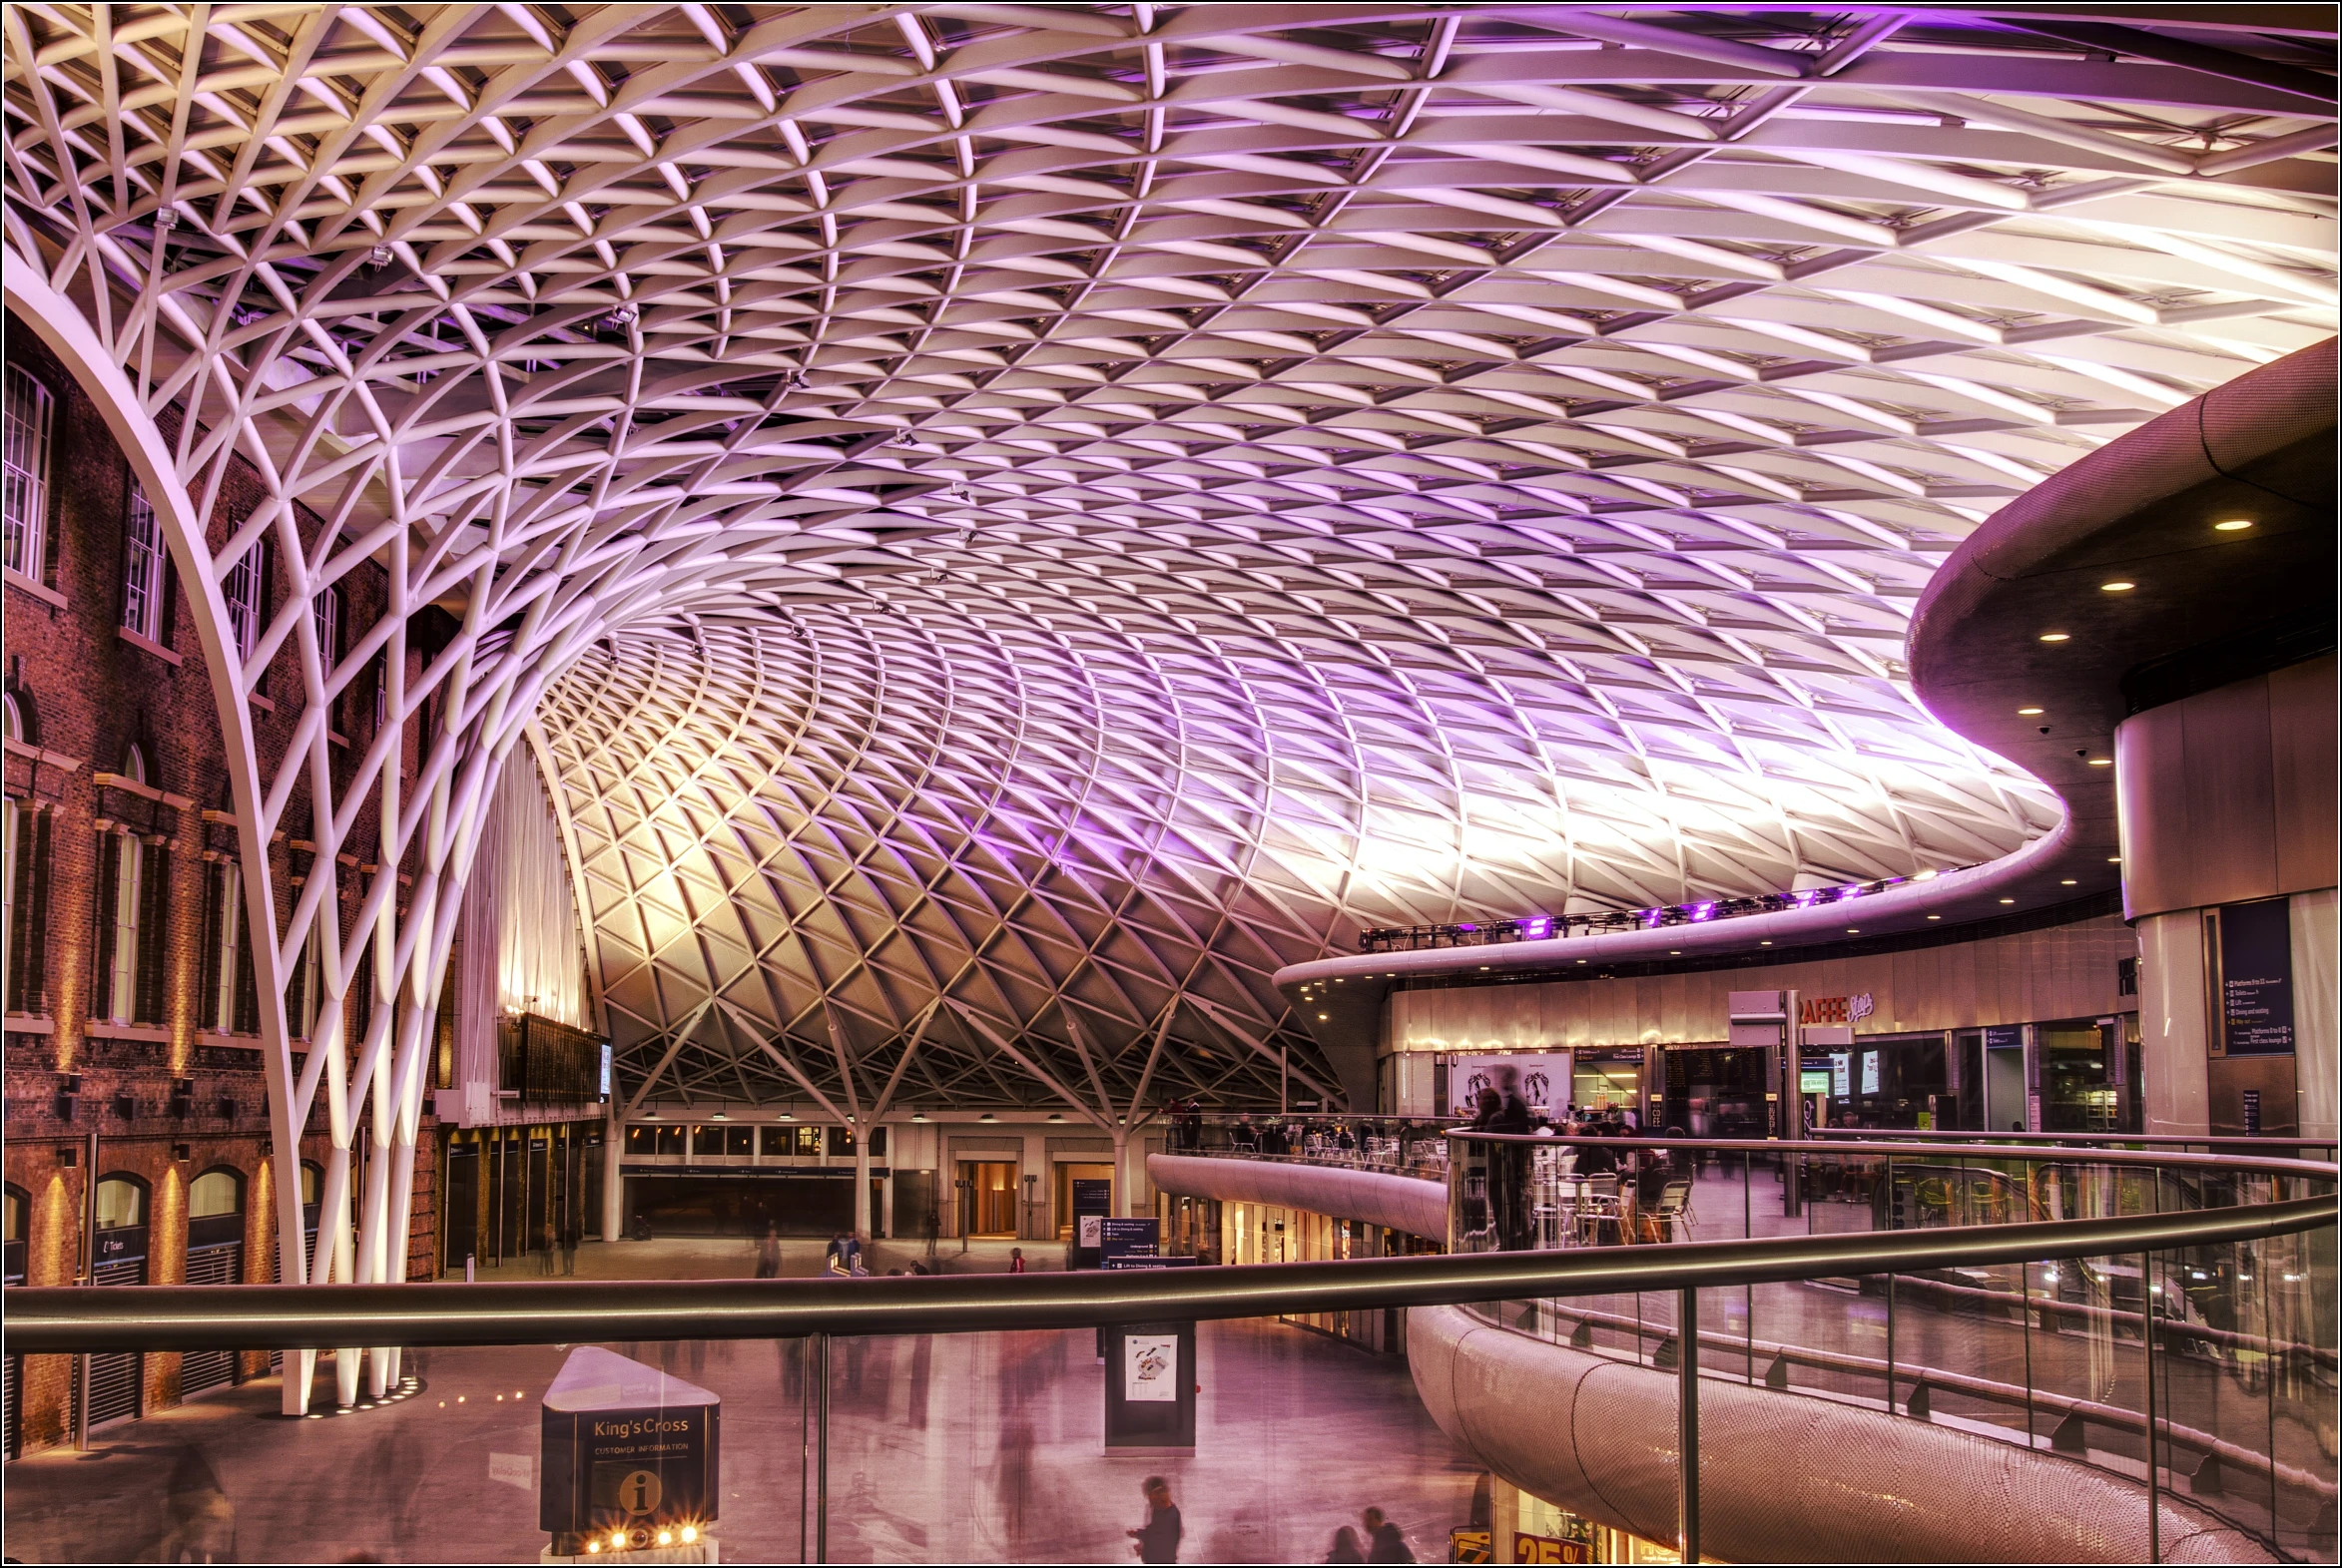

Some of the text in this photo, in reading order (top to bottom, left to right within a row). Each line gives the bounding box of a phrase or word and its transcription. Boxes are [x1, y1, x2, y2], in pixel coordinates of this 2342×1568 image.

[110, 1241, 124, 1251] Tickets
[595, 1418, 689, 1437] King's Cross
[595, 1443, 689, 1455] CUSTOMER INFORMATION
